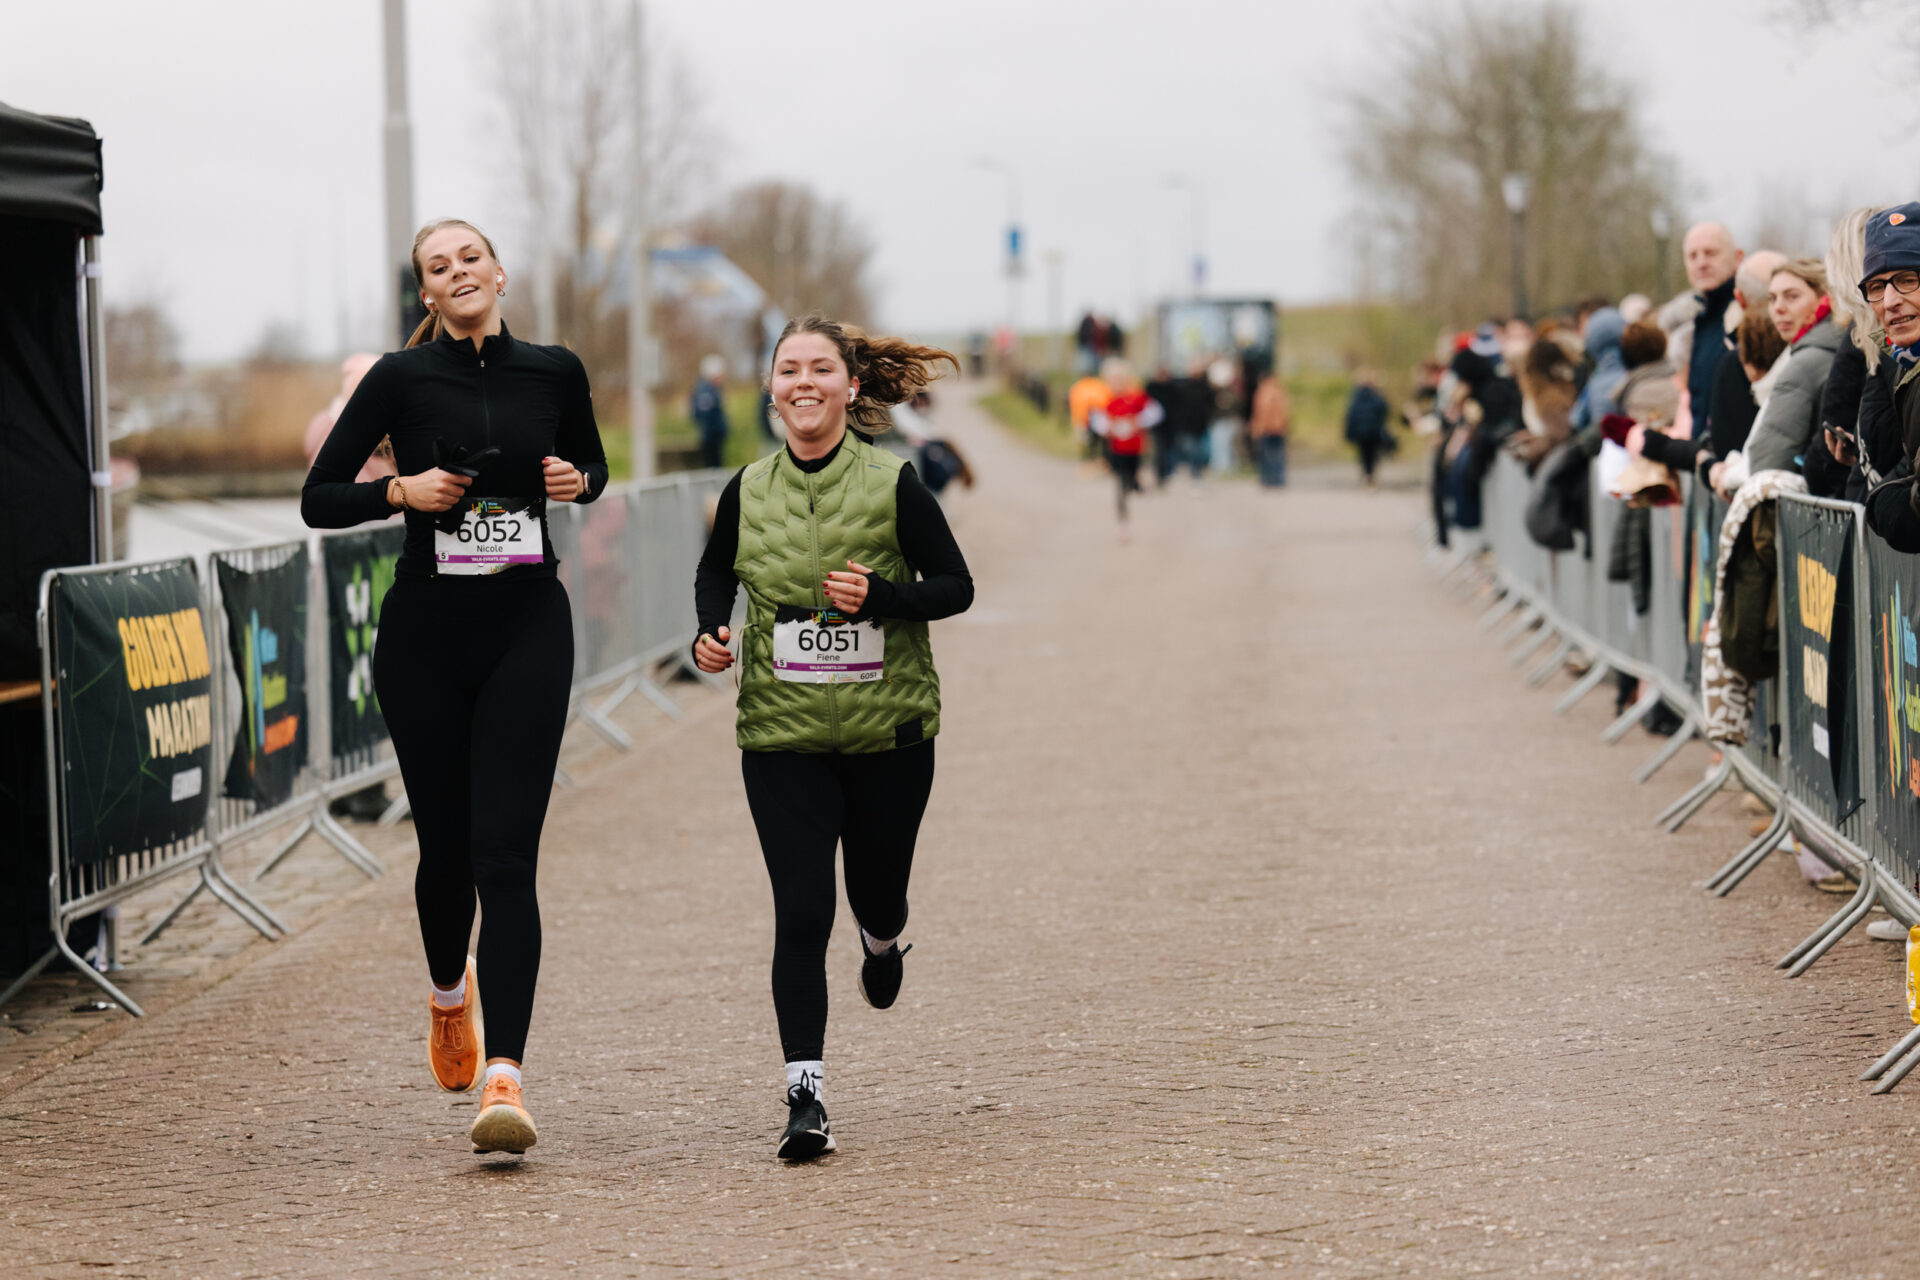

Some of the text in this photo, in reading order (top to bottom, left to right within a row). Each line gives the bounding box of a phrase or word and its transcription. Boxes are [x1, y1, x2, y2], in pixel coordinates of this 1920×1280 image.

[456, 519, 522, 543] 6052
[476, 545, 504, 553] Nicole
[440, 552, 446, 560] 5
[798, 628, 859, 652] 6051
[816, 653, 841, 662] Fiene
[860, 672, 877, 680] 6051
